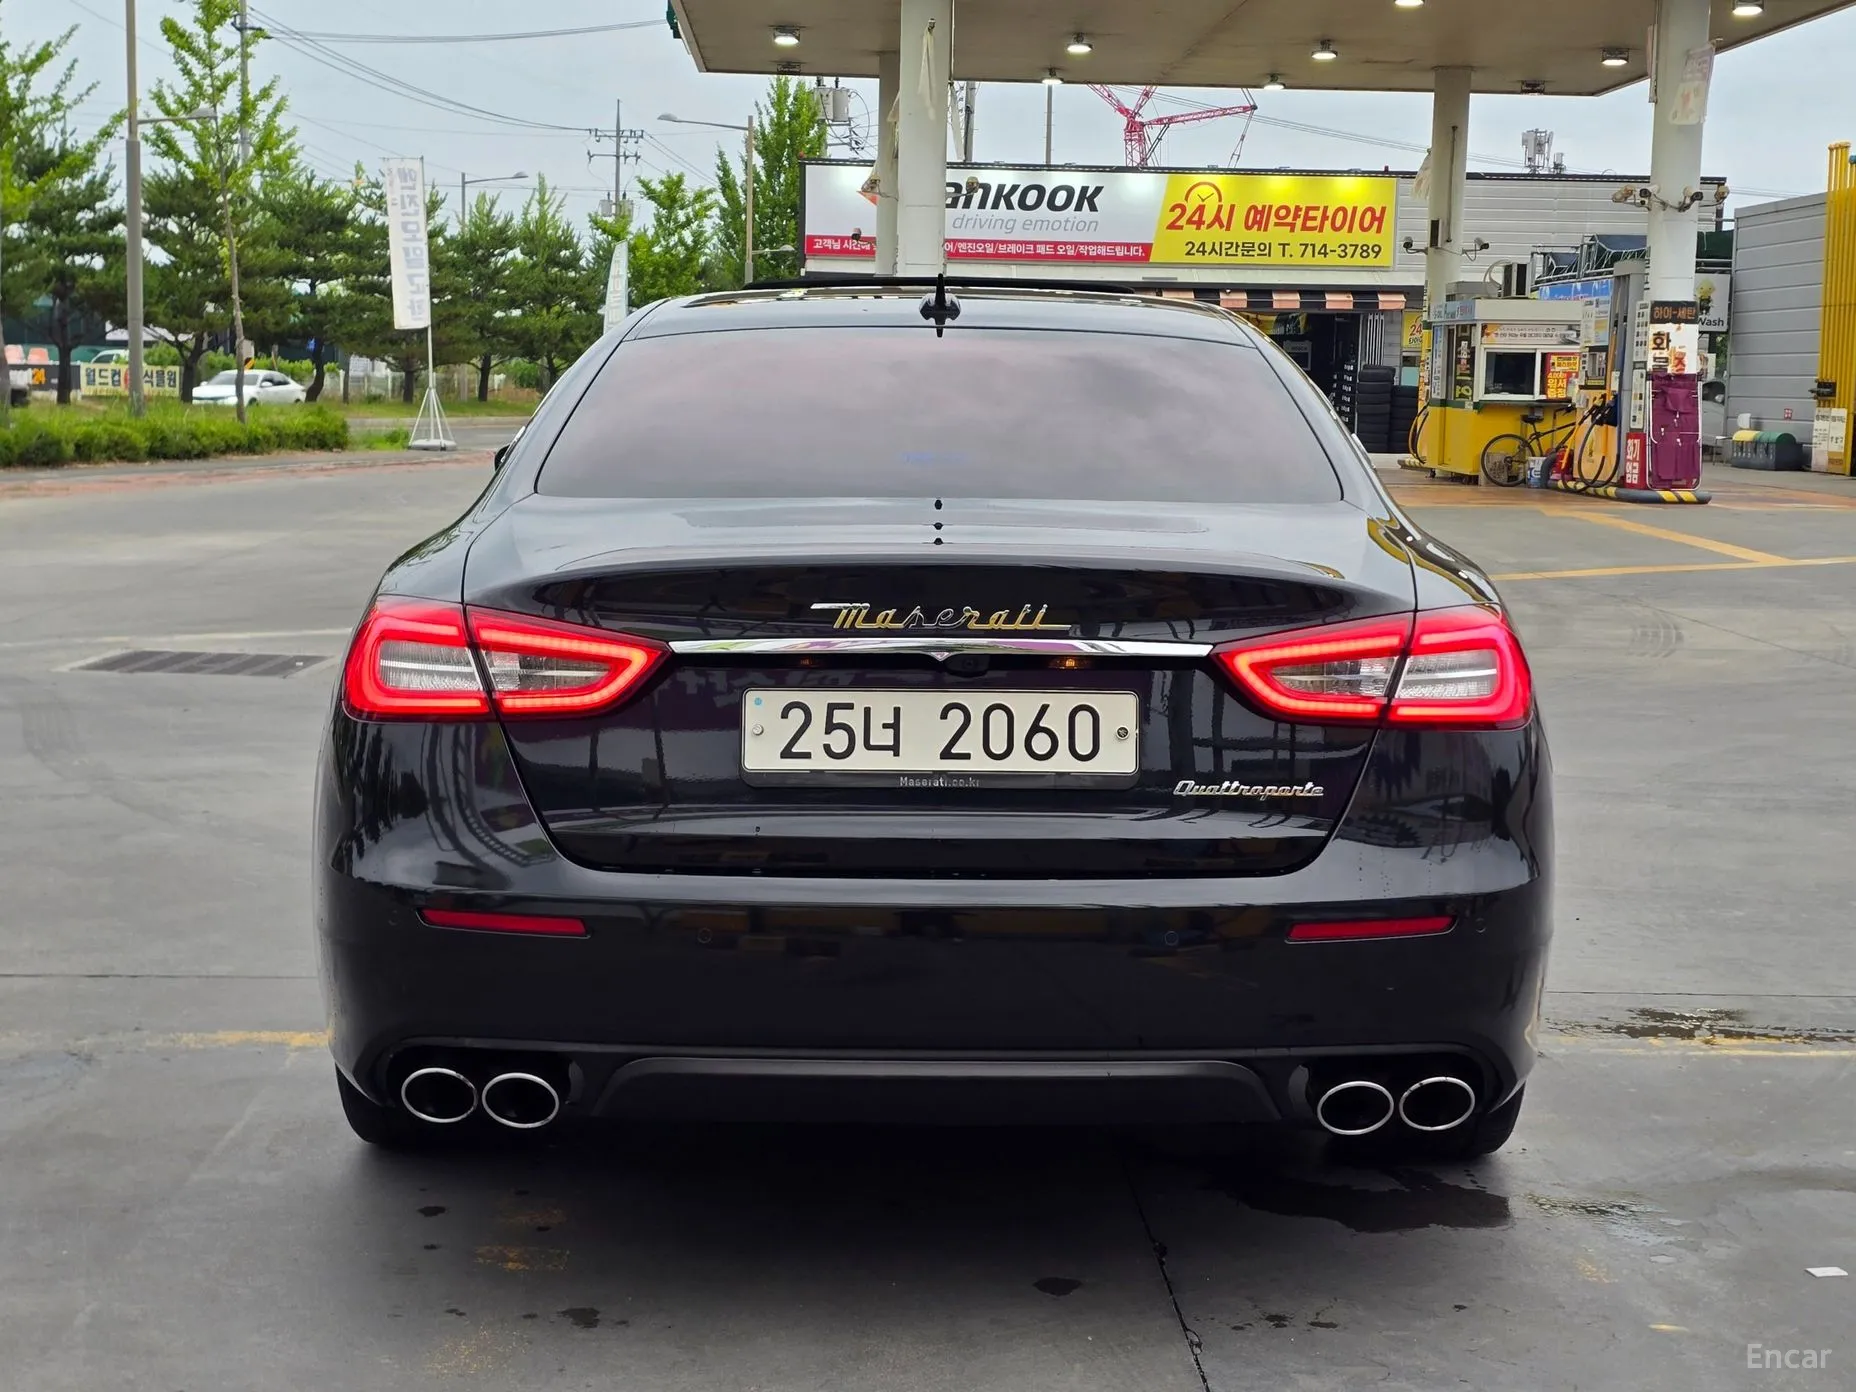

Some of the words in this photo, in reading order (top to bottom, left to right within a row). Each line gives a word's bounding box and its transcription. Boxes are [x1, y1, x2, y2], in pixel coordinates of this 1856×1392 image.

[952, 214, 1017, 234] driving
[1022, 216, 1099, 233] emotion
[1166, 203, 1236, 232] 24시
[1244, 204, 1387, 234] 예약타이어
[813, 238, 841, 250] 고객님
[944, 241, 1035, 255] 어/엔진오일/브레이크
[1036, 244, 1054, 255] 패드
[1185, 241, 1272, 258] 24시간문의
[1278, 243, 1293, 258] T.
[1299, 243, 1383, 259] 714-3789
[1653, 306, 1696, 320] 하이-세탄
[143, 368, 178, 389] 식물원
[1626, 438, 1641, 460] 화기
[779, 700, 901, 761] 25너
[938, 702, 1101, 763] 2060
[1173, 780, 1324, 801] Quattroporte
